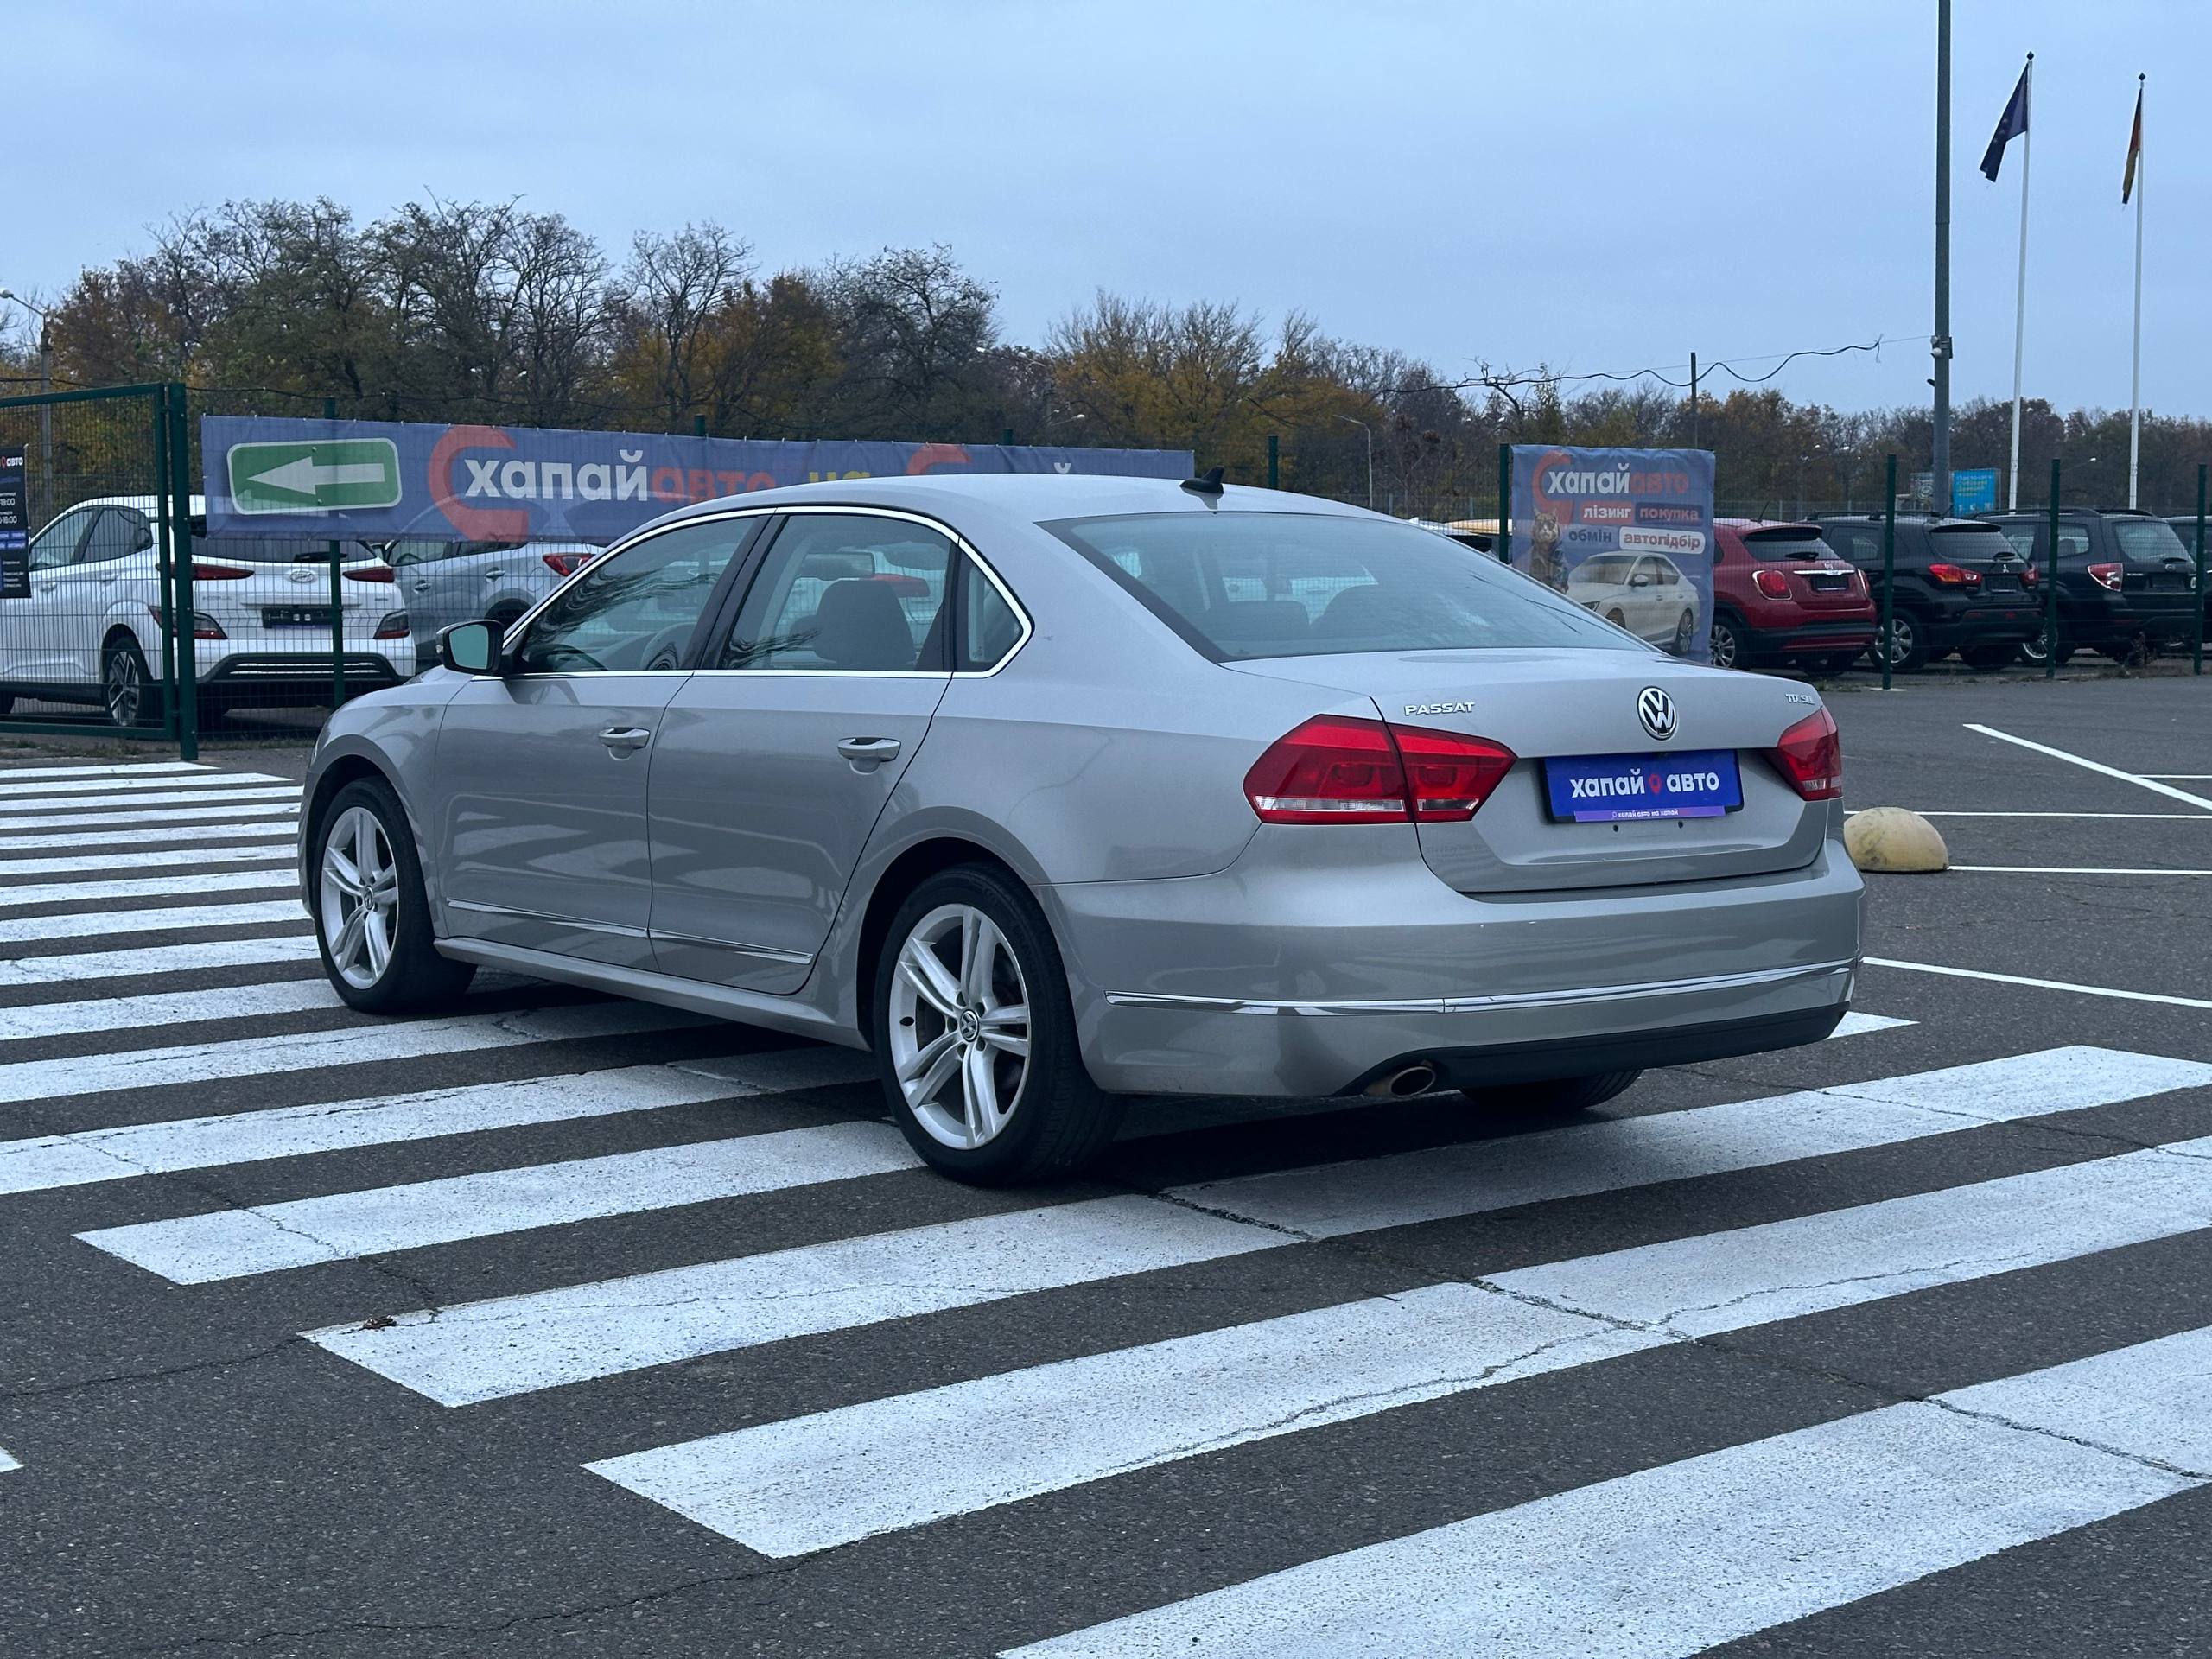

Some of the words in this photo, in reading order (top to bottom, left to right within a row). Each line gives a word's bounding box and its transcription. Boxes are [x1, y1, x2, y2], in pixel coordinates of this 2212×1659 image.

[1583, 505, 1632, 518] лізинг
[1639, 507, 1700, 521] покупка
[1568, 529, 1612, 543] обмін
[1624, 531, 1701, 550] автопідбір
[1404, 702, 1476, 716] PASSAT
[1569, 768, 1645, 798] хапай
[1666, 772, 1719, 793] авто
